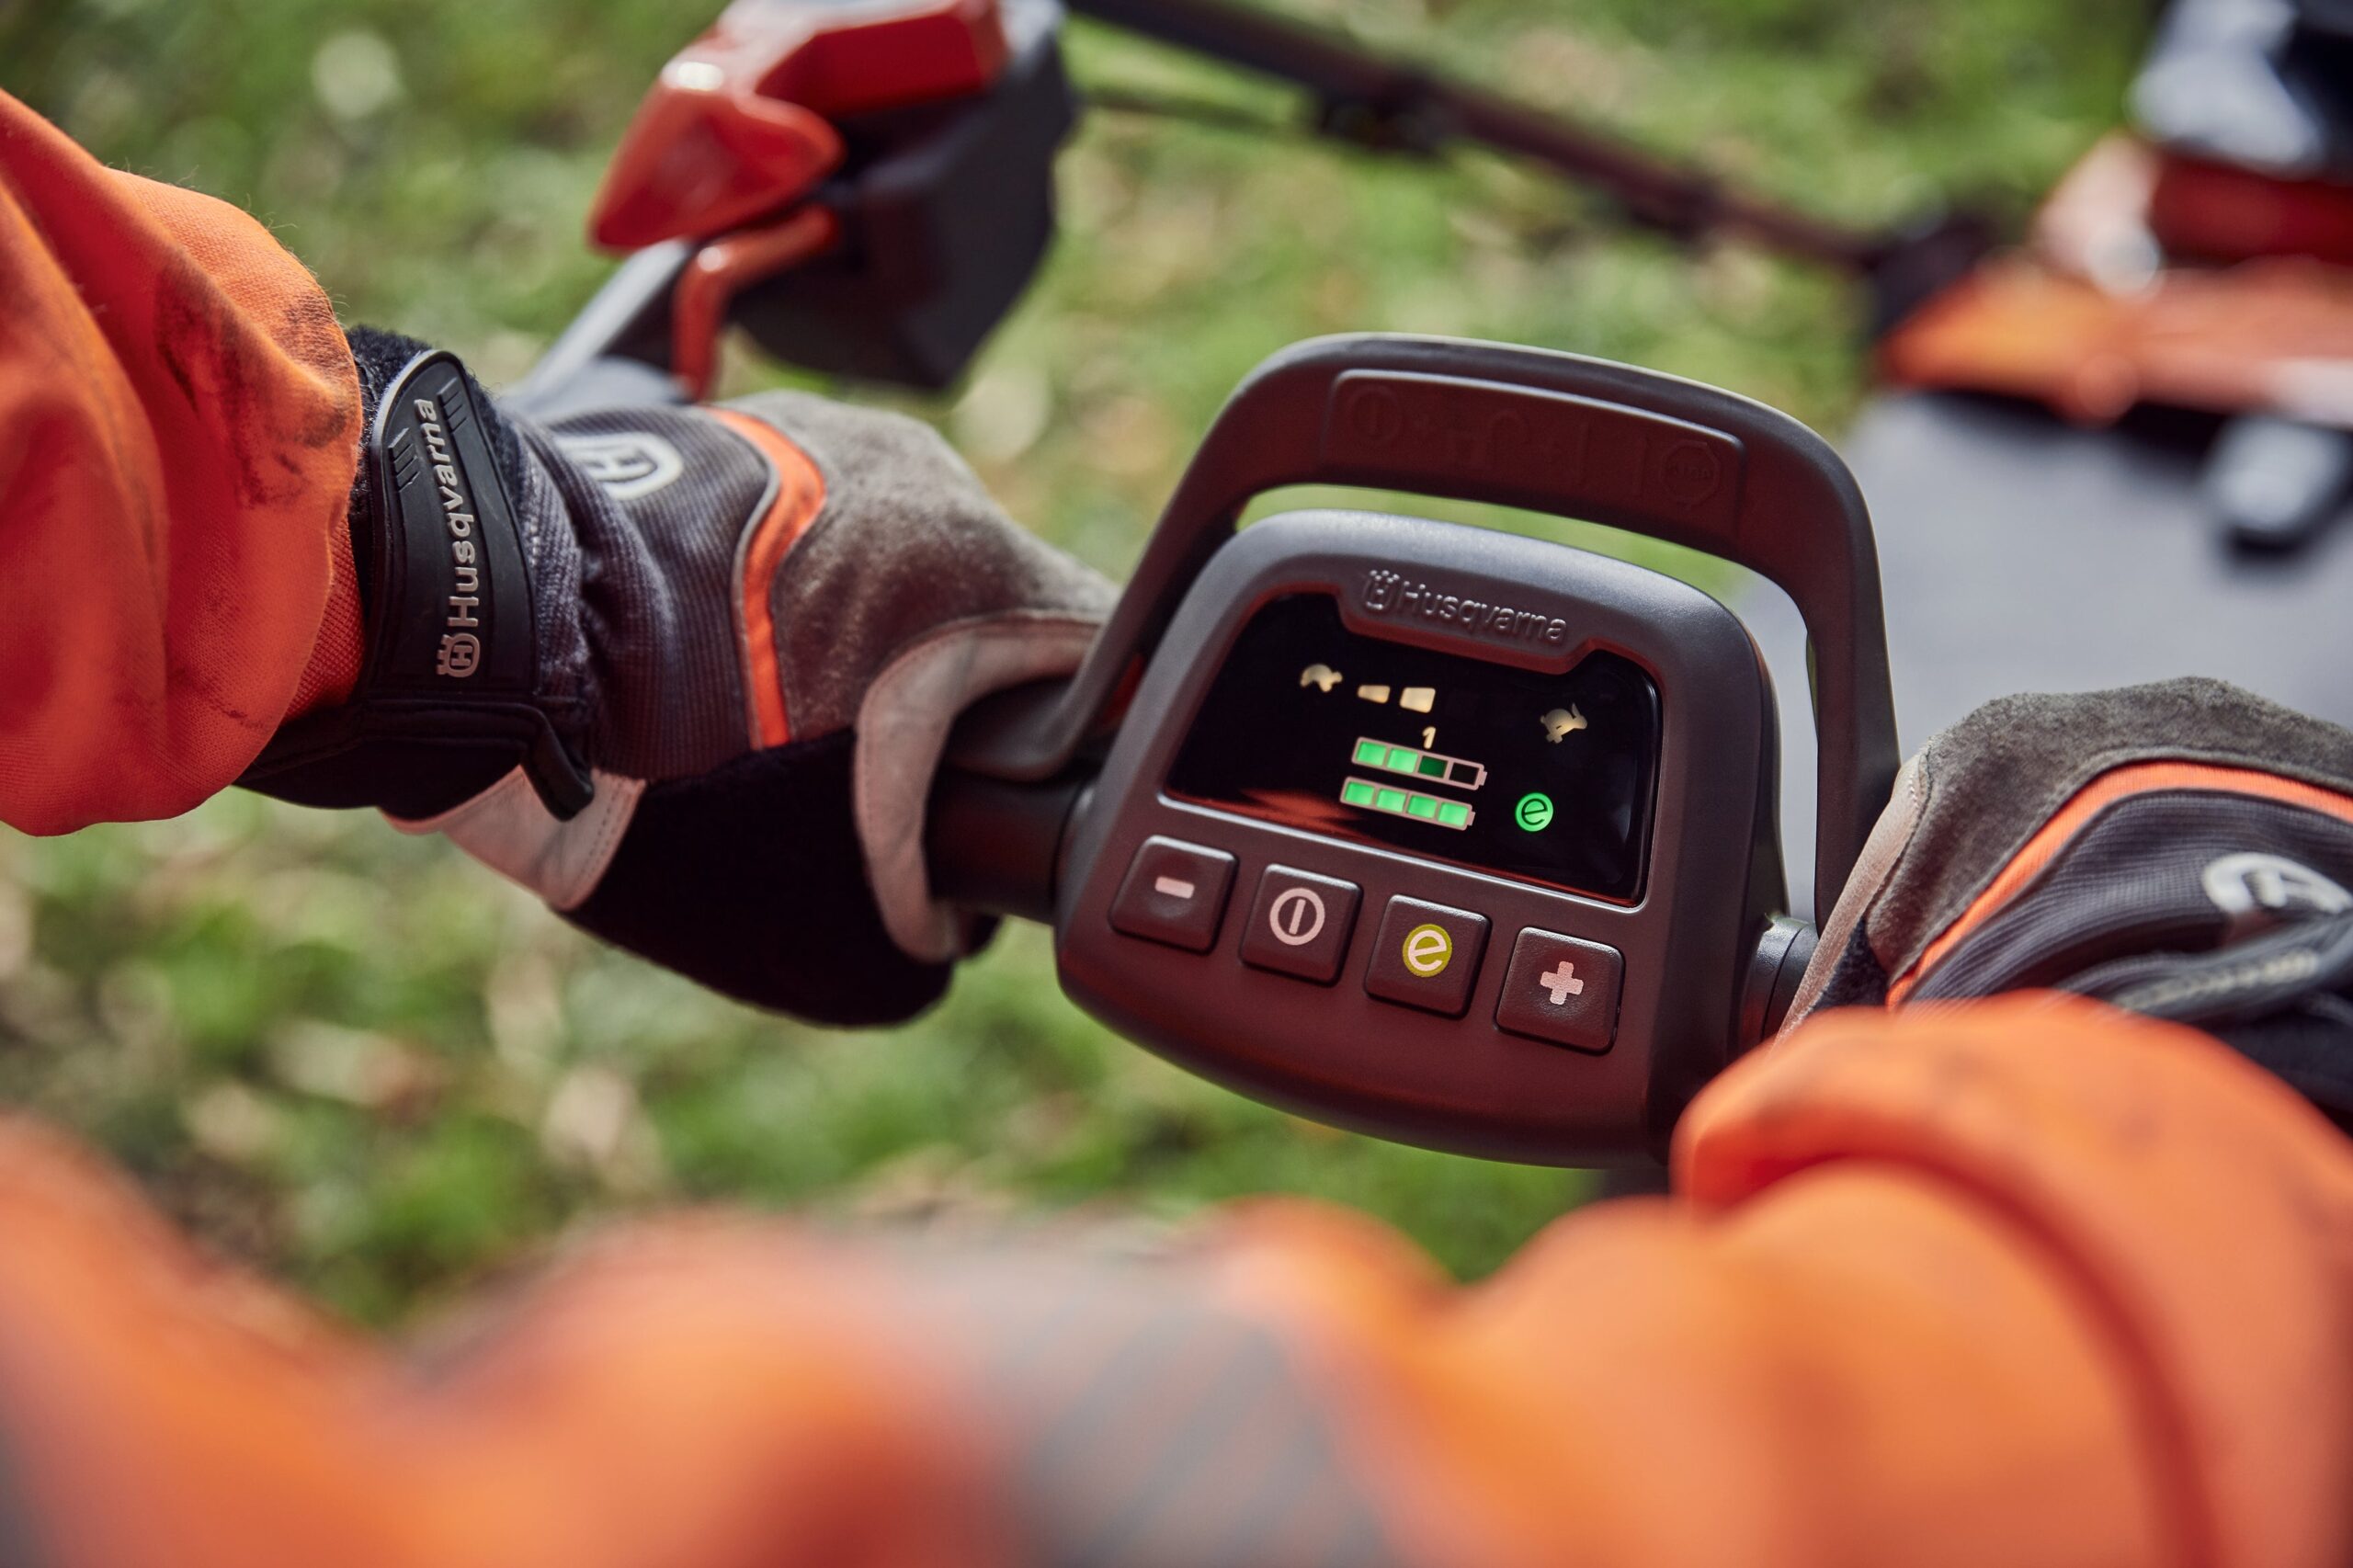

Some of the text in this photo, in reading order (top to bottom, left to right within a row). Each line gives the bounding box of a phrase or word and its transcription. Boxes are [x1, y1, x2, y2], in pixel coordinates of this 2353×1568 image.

[415, 400, 479, 627] Husqvarna
[1397, 581, 1566, 642] Husqvarna
[1423, 726, 1436, 749] 1
[1522, 798, 1548, 825] e
[1408, 930, 1447, 971] e
